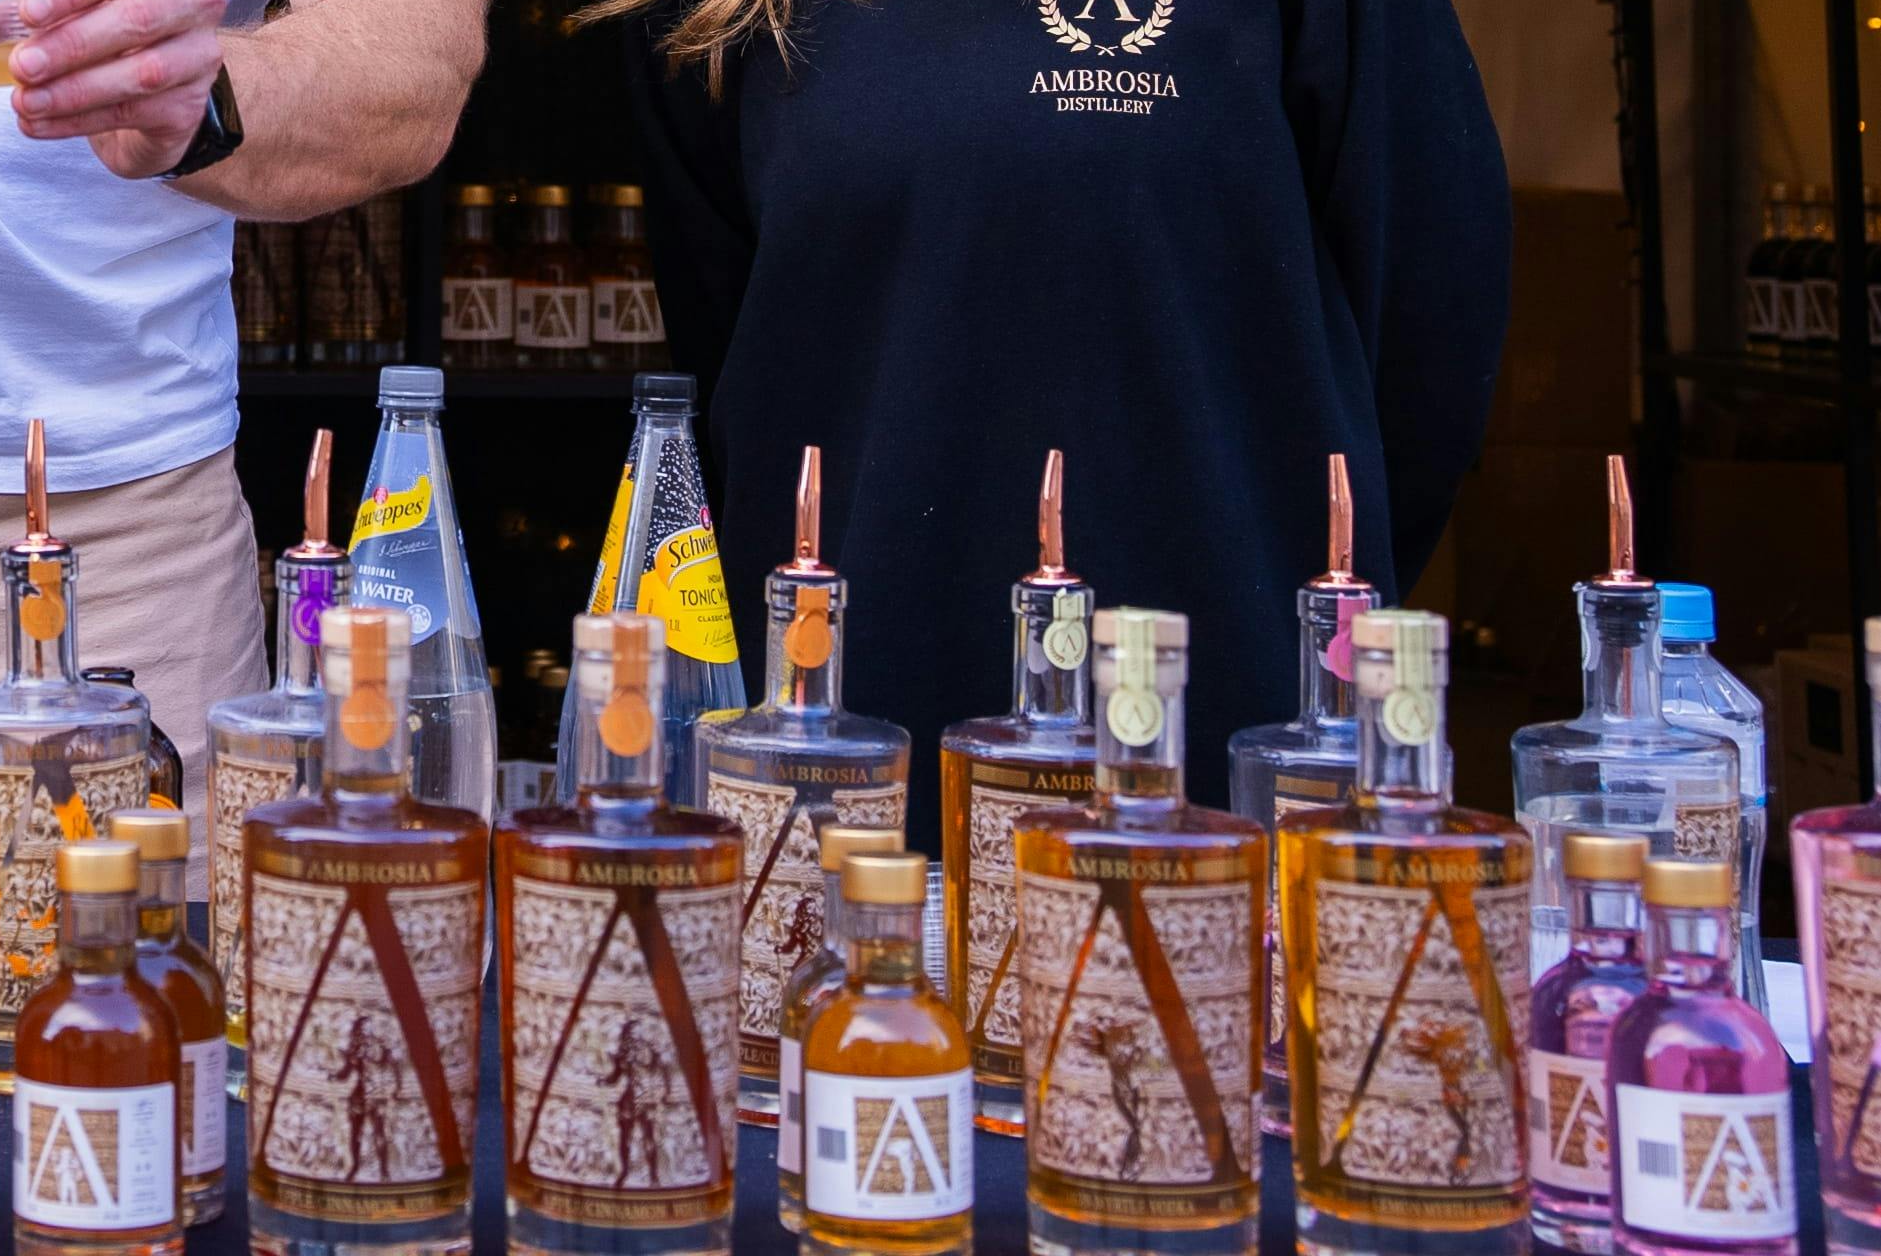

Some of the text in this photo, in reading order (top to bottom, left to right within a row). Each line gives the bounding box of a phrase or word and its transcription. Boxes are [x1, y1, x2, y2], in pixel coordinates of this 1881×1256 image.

[1029, 69, 1180, 98] AMBROSIA
[1056, 97, 1154, 115] DISTILLERY
[358, 565, 396, 580] ORIGINAL
[361, 580, 414, 605] WATER
[680, 588, 717, 607] TONIC
[1034, 773, 1096, 791] AMBR
[307, 859, 431, 884] AMBROSIA
[575, 861, 699, 886] AMBROSIA
[1068, 855, 1187, 881] AMBROSIA
